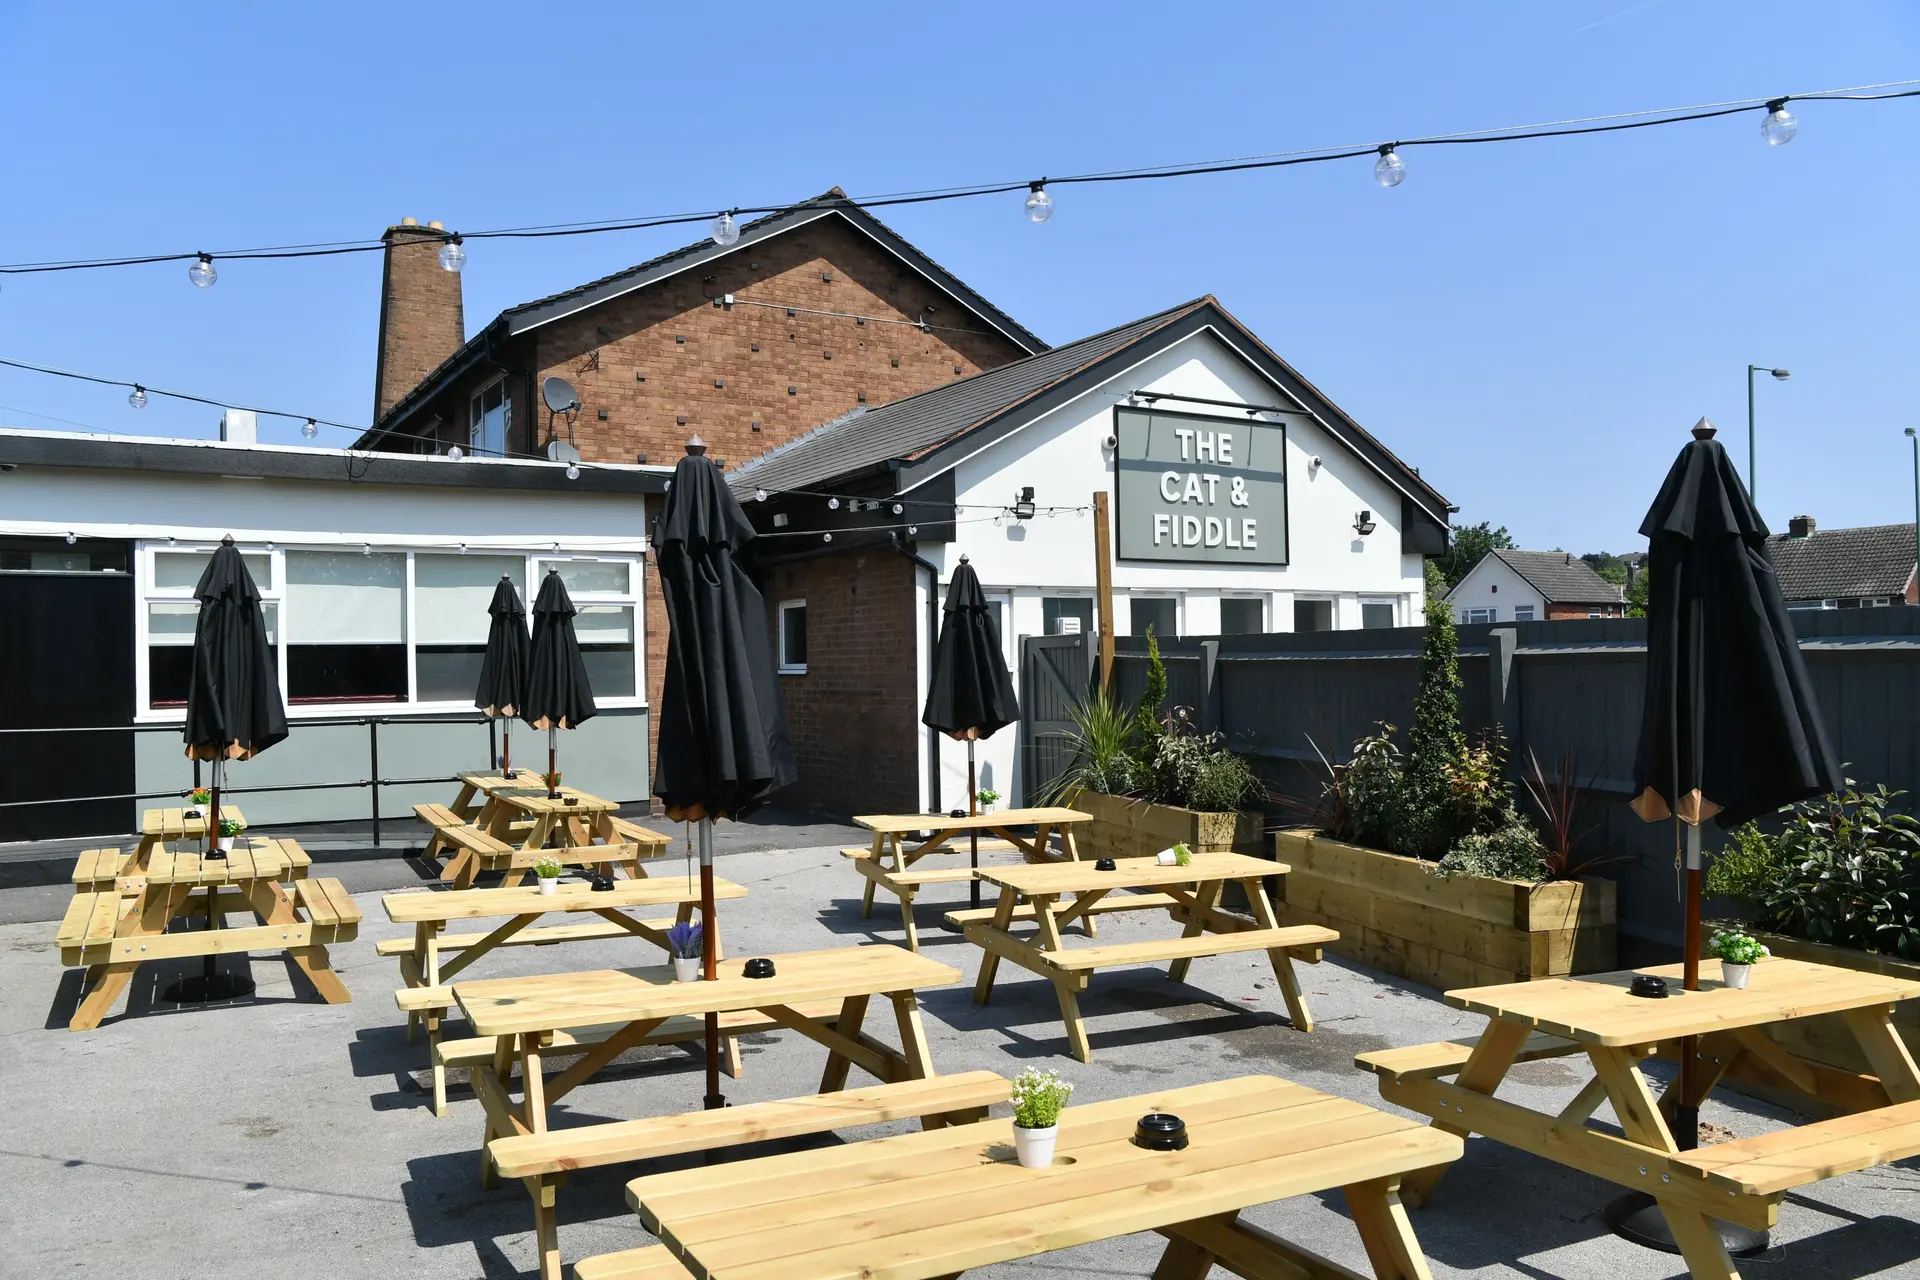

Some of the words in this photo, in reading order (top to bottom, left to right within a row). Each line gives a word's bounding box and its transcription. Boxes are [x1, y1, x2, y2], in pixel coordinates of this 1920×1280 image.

[1174, 428, 1233, 464] THE
[1160, 470, 1221, 504] CAT
[1231, 475, 1249, 507] &
[1153, 513, 1258, 549] FIDDLE
